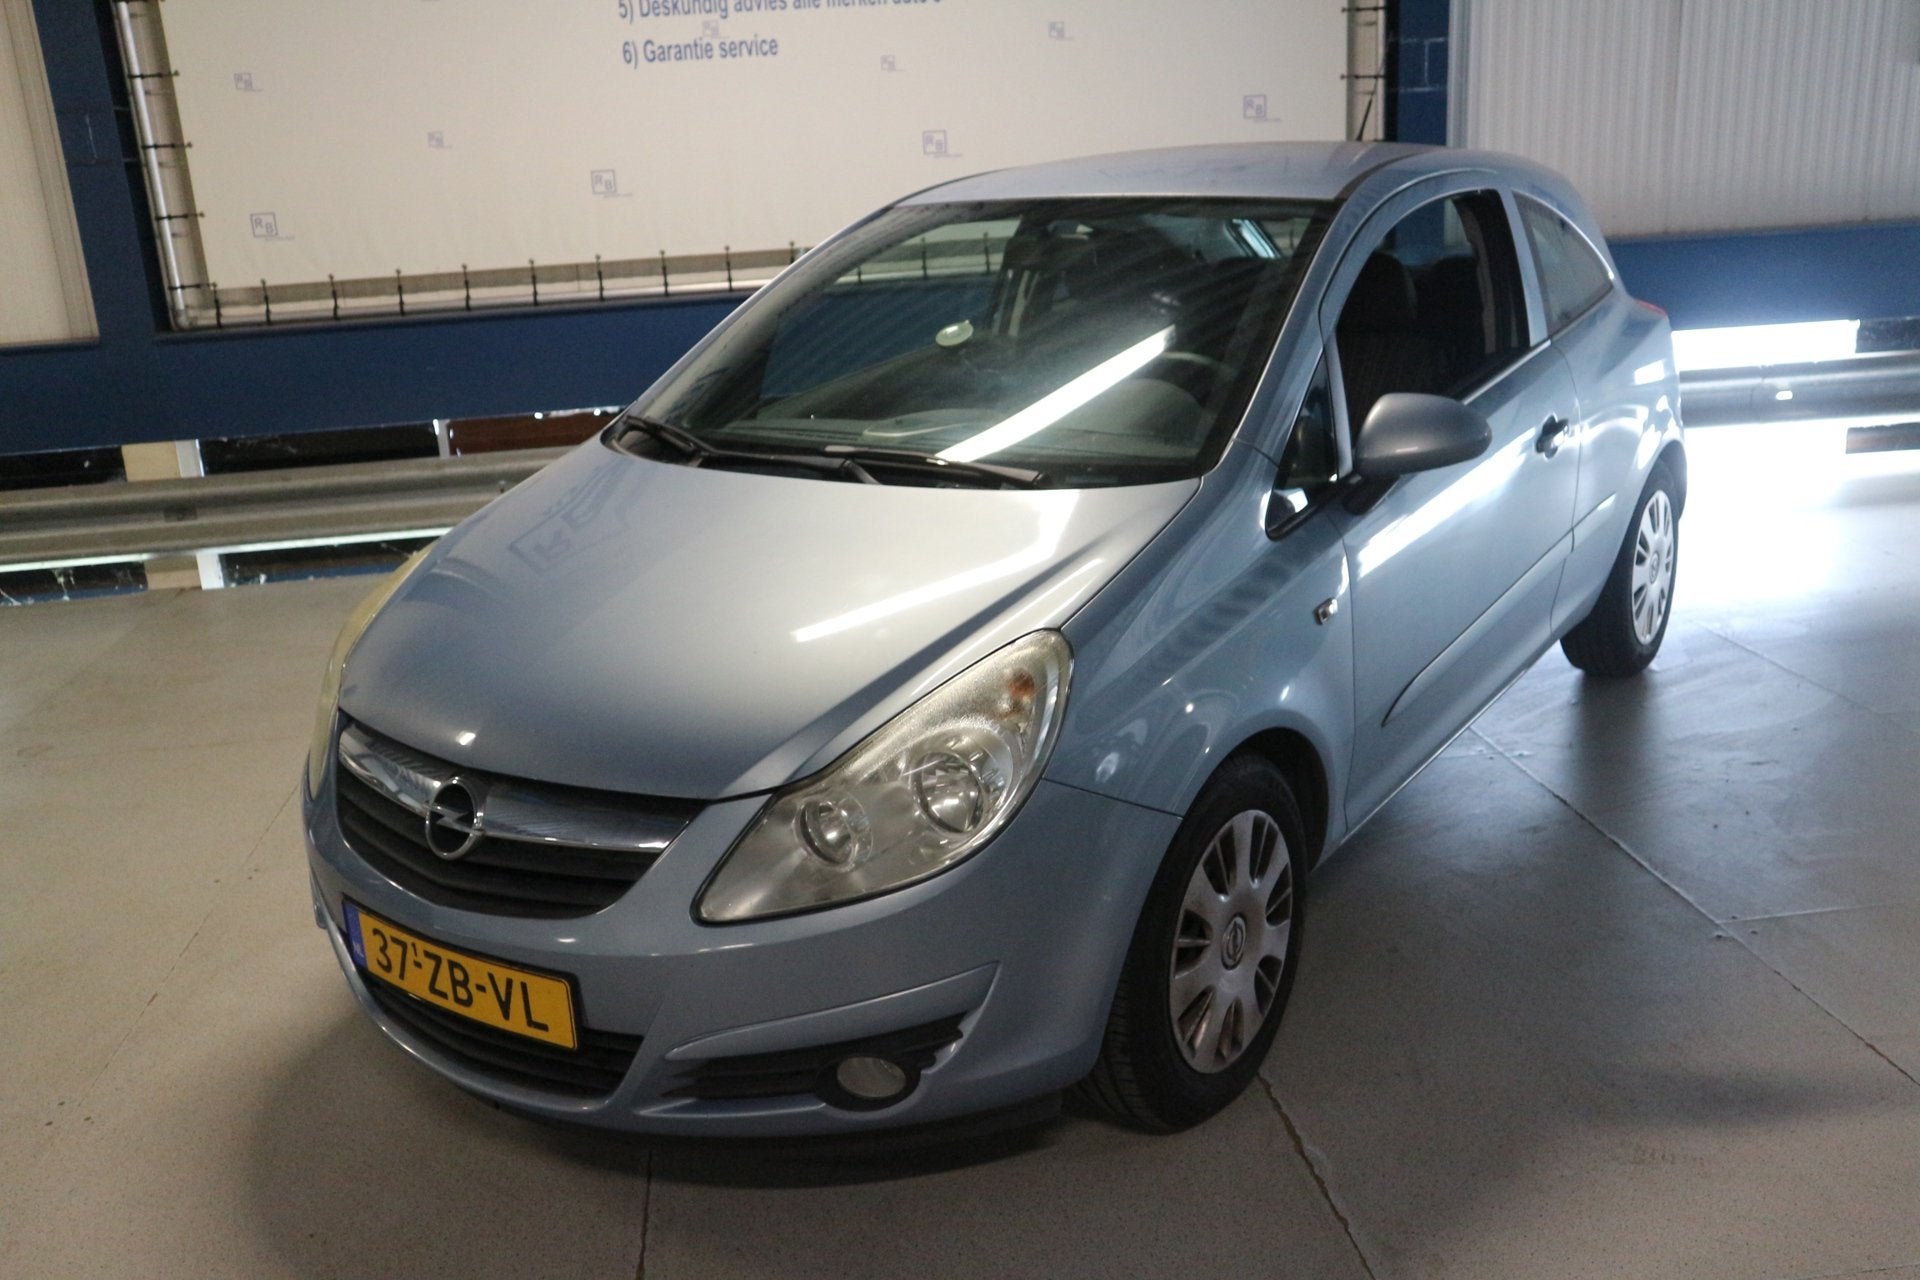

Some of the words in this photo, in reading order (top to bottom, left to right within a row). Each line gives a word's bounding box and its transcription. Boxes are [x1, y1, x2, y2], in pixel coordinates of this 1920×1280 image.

[639, 0, 728, 19] Deskundig
[622, 40, 638, 69] 6)
[643, 37, 714, 63] Garantie
[719, 33, 778, 58] service
[372, 928, 549, 1032] 37-ZB-VL
